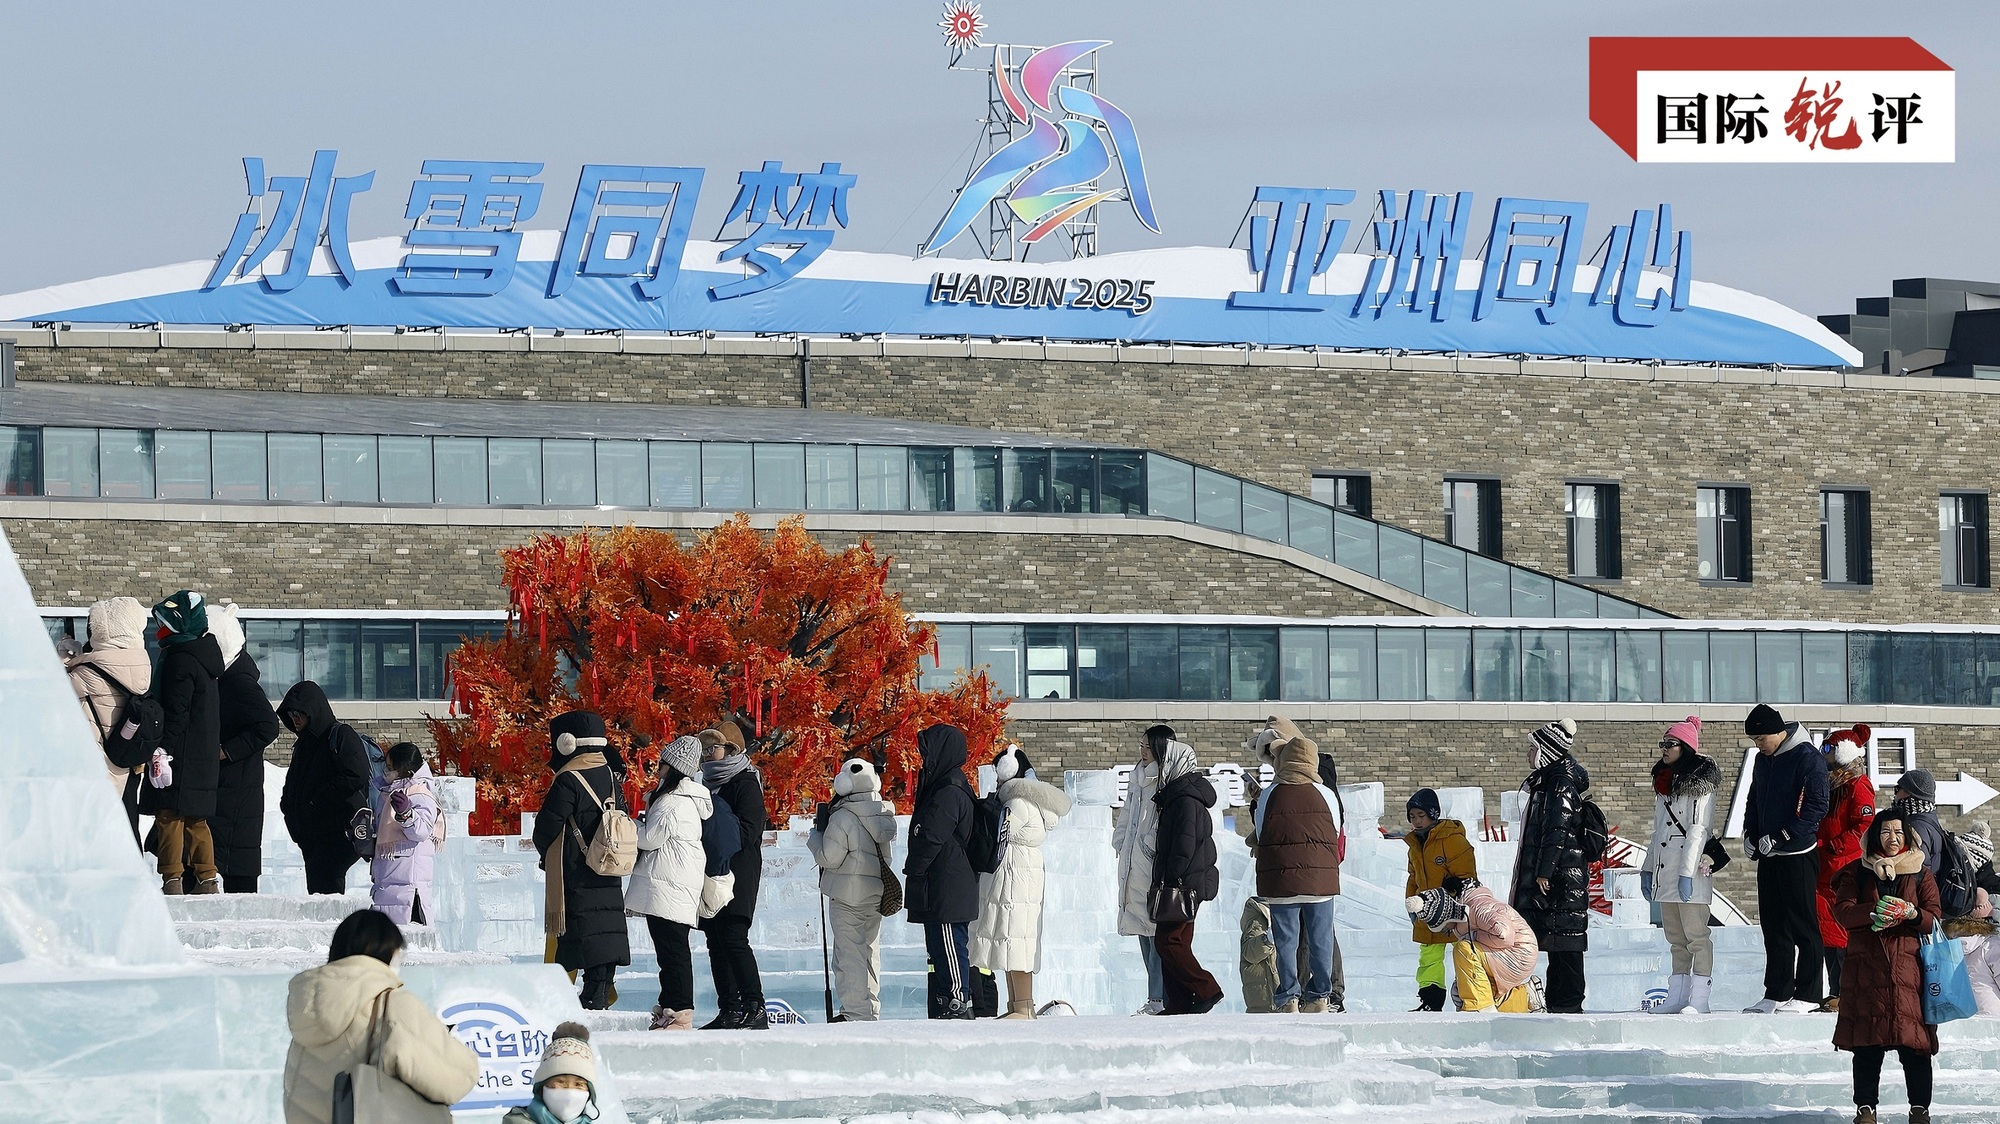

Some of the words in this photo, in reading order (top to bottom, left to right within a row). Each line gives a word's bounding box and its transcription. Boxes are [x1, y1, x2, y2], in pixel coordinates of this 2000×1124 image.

[202, 150, 858, 301] 冰雪同梦
[931, 272, 1067, 308] HARBIN
[1073, 277, 1156, 316] 2025
[1226, 185, 1692, 327] 亚洲同心
